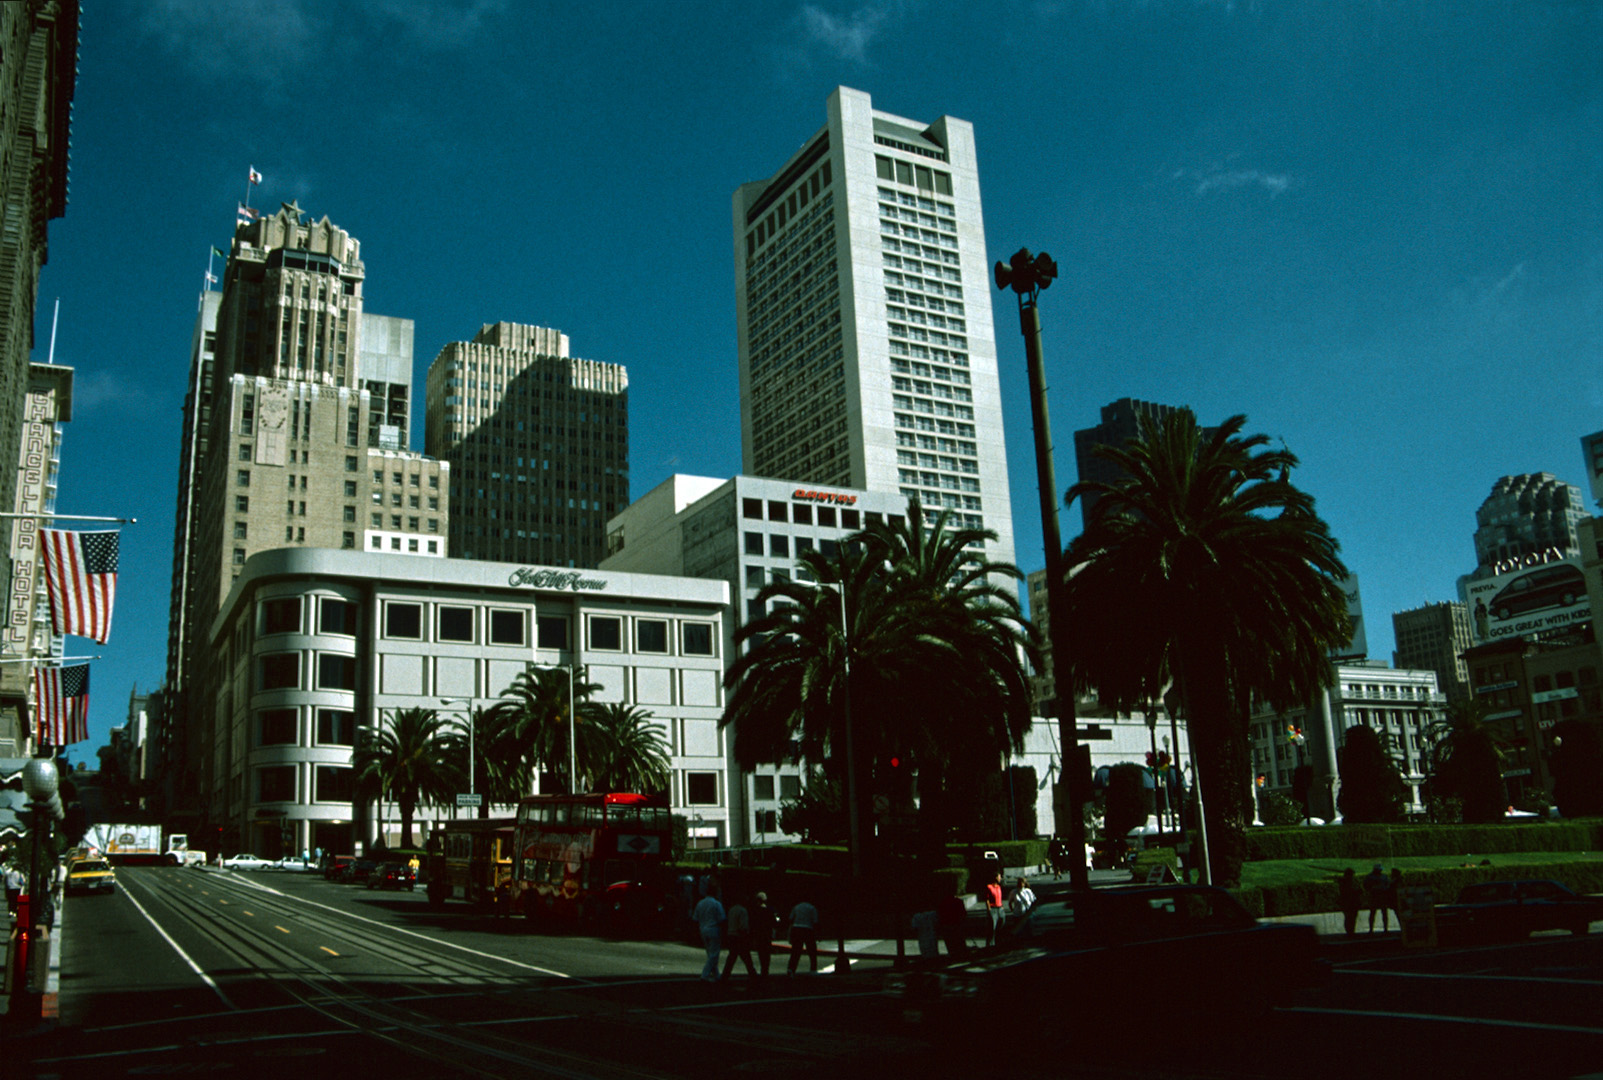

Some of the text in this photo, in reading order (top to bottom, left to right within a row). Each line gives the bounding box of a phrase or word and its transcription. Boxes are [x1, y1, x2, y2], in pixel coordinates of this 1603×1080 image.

[792, 489, 857, 505] QANTAS
[11, 387, 48, 642] CHANCELLOR HOTEL
[1493, 546, 1564, 576] TOYOTA
[508, 567, 607, 591] Saks Fifth Avenue
[1490, 607, 1591, 637] GOES GREAT WITH KIDS
